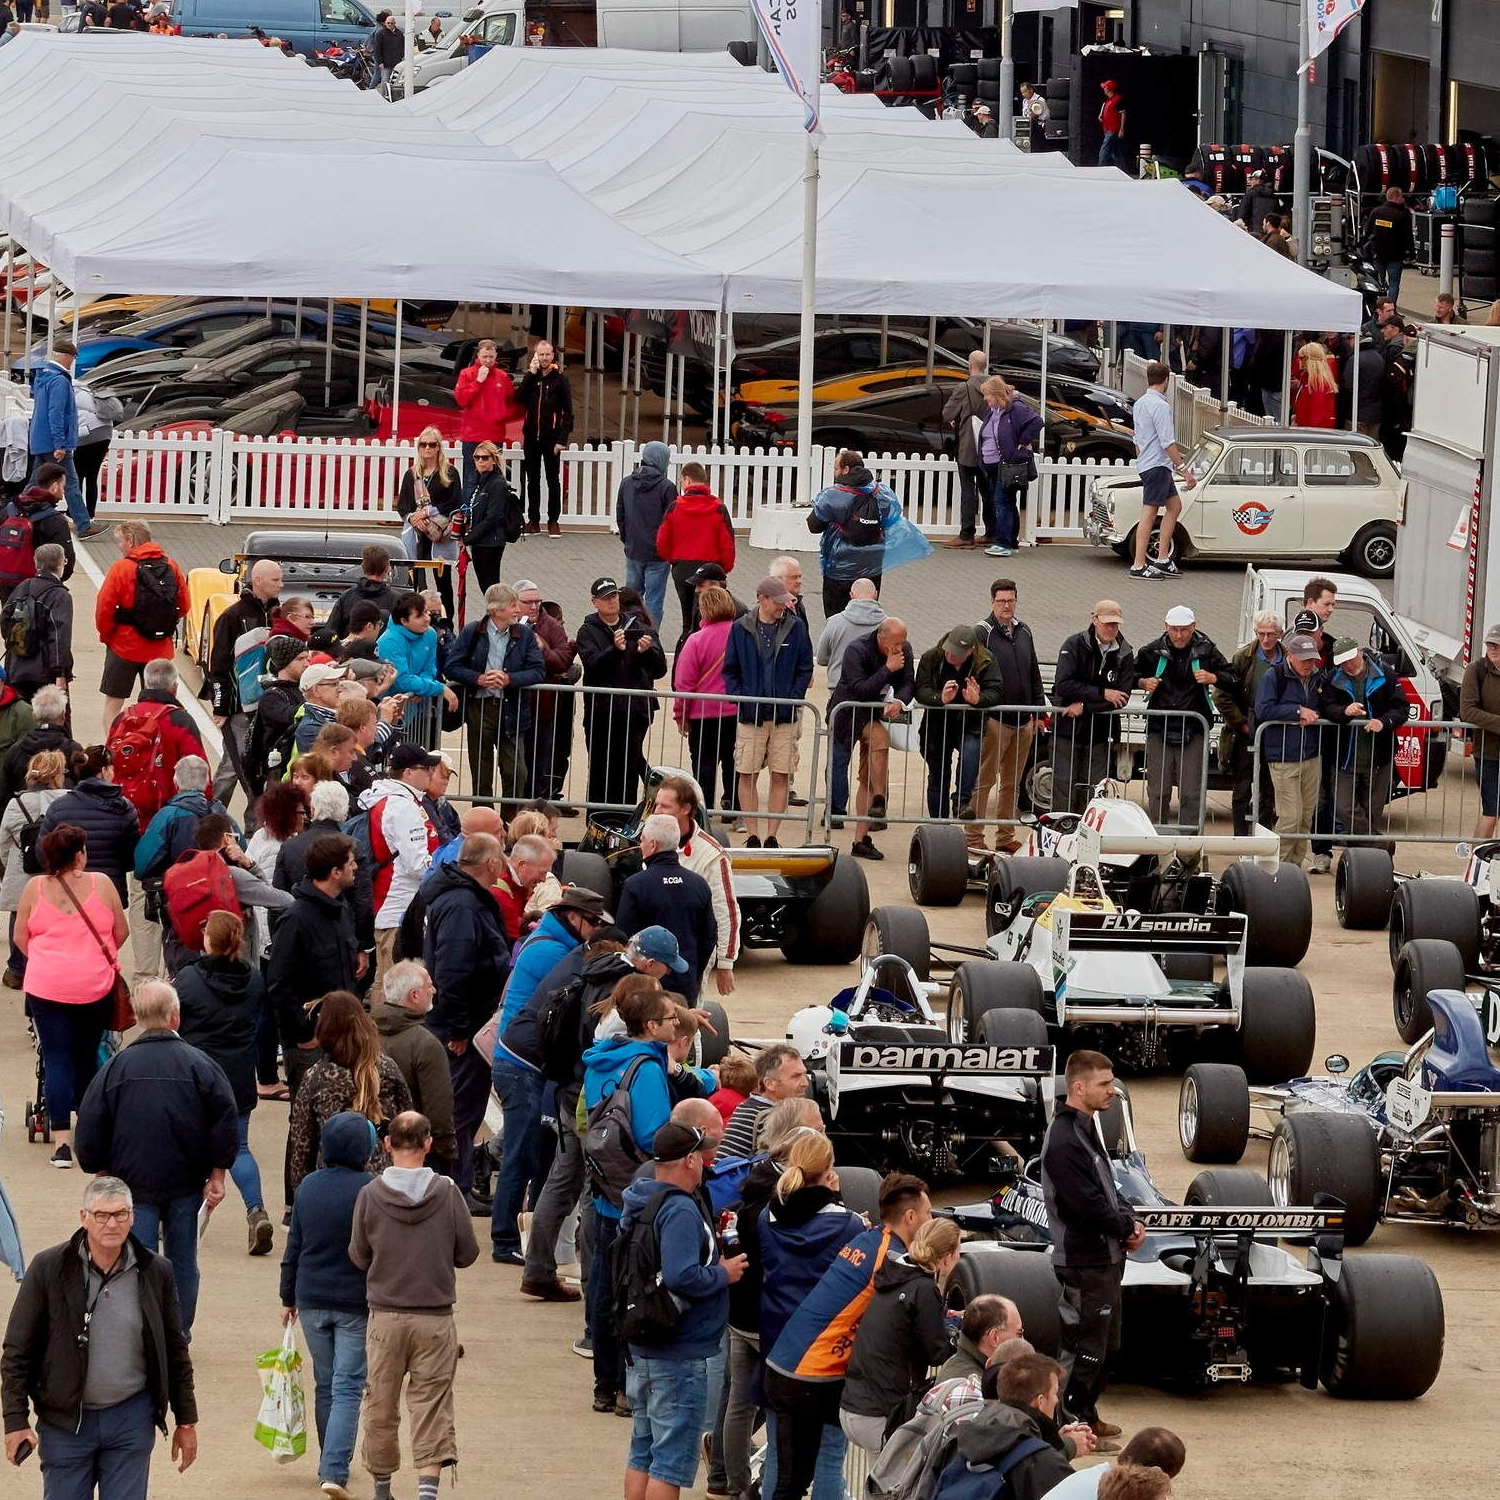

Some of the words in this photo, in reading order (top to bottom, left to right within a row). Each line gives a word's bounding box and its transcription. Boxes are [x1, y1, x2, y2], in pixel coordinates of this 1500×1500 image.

[1102, 915, 1140, 930] FLY
[1140, 918, 1212, 932] saudia
[852, 1046, 1041, 1071] parmalat
[1145, 1212, 1194, 1228] CAFE
[1225, 1212, 1326, 1229] COLOMBIA
[850, 1248, 866, 1268] RC
